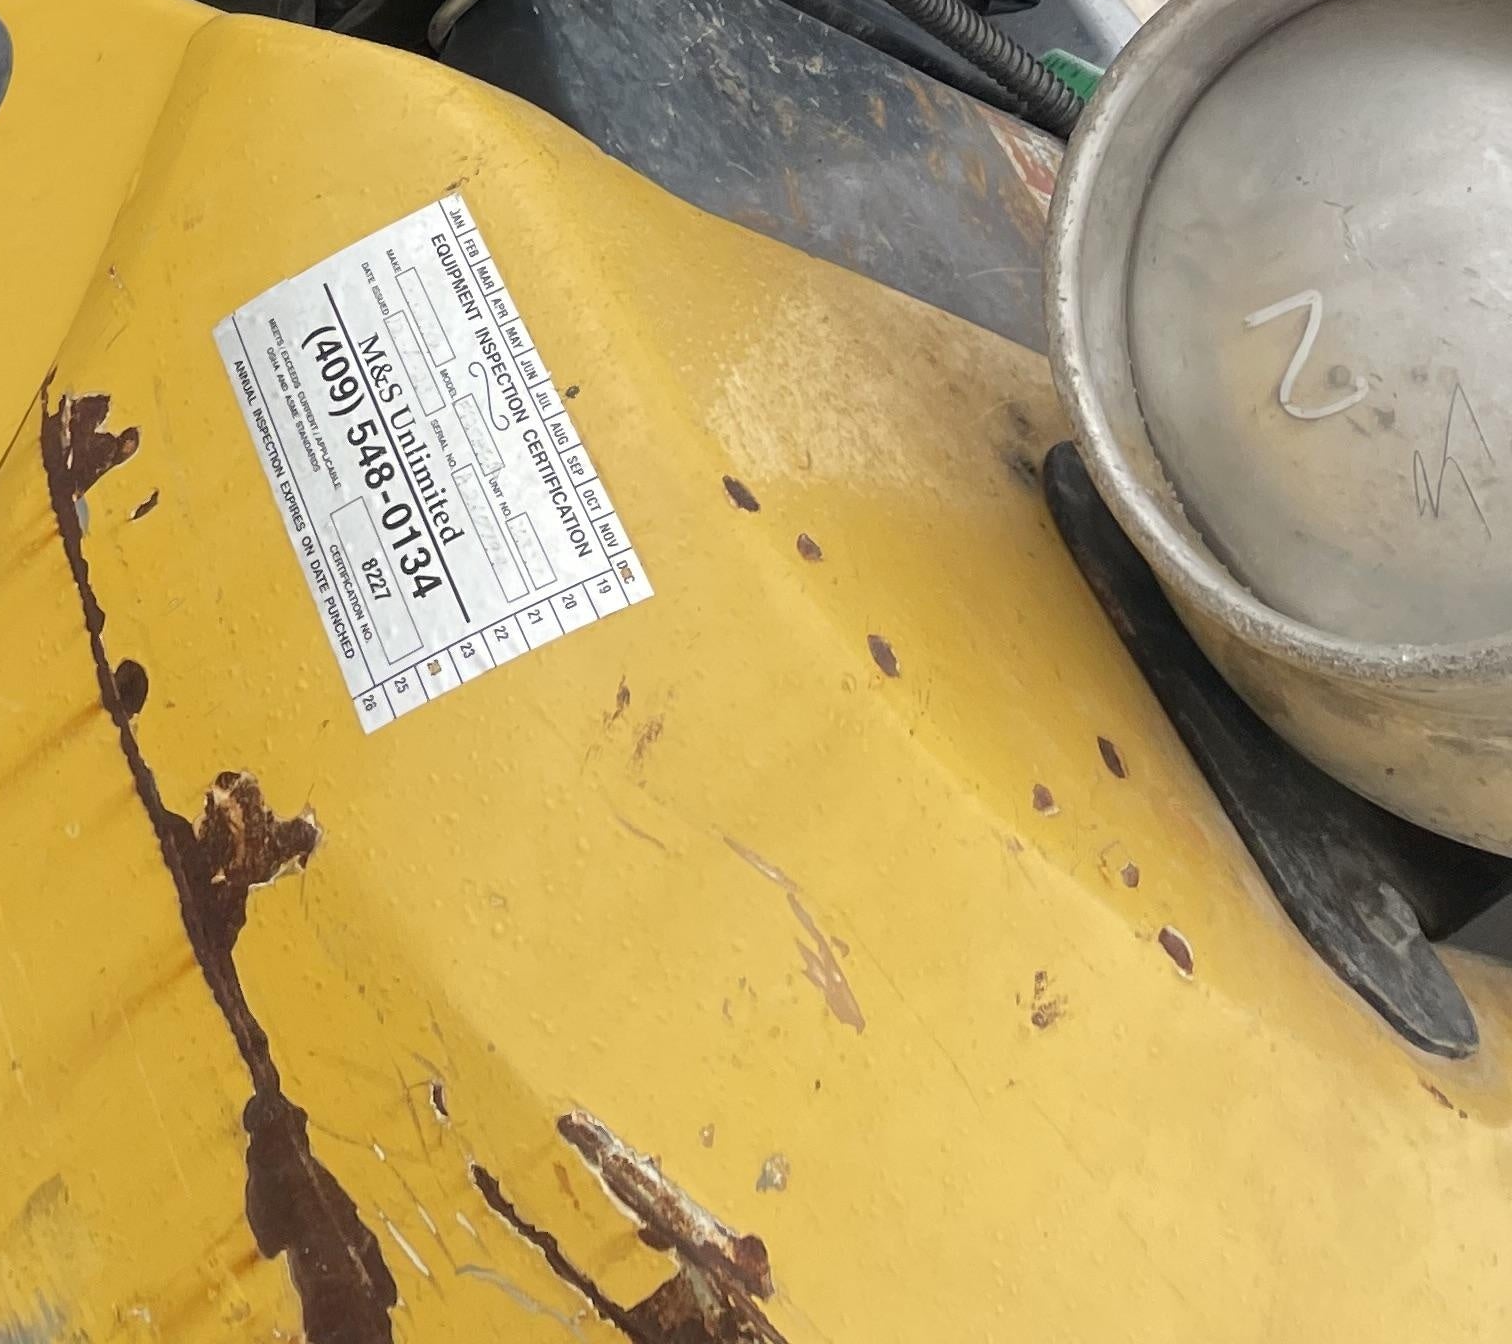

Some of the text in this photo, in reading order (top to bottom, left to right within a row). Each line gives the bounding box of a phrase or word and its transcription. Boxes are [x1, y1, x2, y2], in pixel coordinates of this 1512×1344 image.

[384, 248, 402, 274] MAKE
[359, 261, 390, 316] DATE ISSUED
[1244, 289, 1369, 419] 2
[428, 231, 484, 325] EQUIPMENT
[472, 325, 531, 425] INSPECTION
[519, 426, 594, 559] CERTIFICATION
[438, 367, 459, 400] MODEL
[448, 206, 636, 586] JAN FEB MAR APR MAY JUN JUL AUG SEP OCT NOV DC
[265, 346, 321, 473] OSHA AND ASME STANDARDS
[296, 319, 369, 423] (409)
[341, 414, 447, 603] 548-0134
[355, 332, 404, 405] M&S
[385, 404, 467, 547] Unlimited
[428, 418, 458, 470] SERIAL NO.
[232, 358, 356, 660] ANNUAL INSPECTION EXPIRES ON DATE PUNCHED
[487, 476, 512, 519] UNIT NO.
[326, 543, 375, 644] CERTIFICATION NO.
[358, 555, 392, 605] 8227
[560, 591, 578, 611] 20
[594, 576, 612, 596] 19
[492, 624, 509, 642] 22
[526, 607, 543, 625] 21
[458, 640, 475, 660] 23
[360, 693, 377, 713] 26
[393, 675, 410, 694] 25
